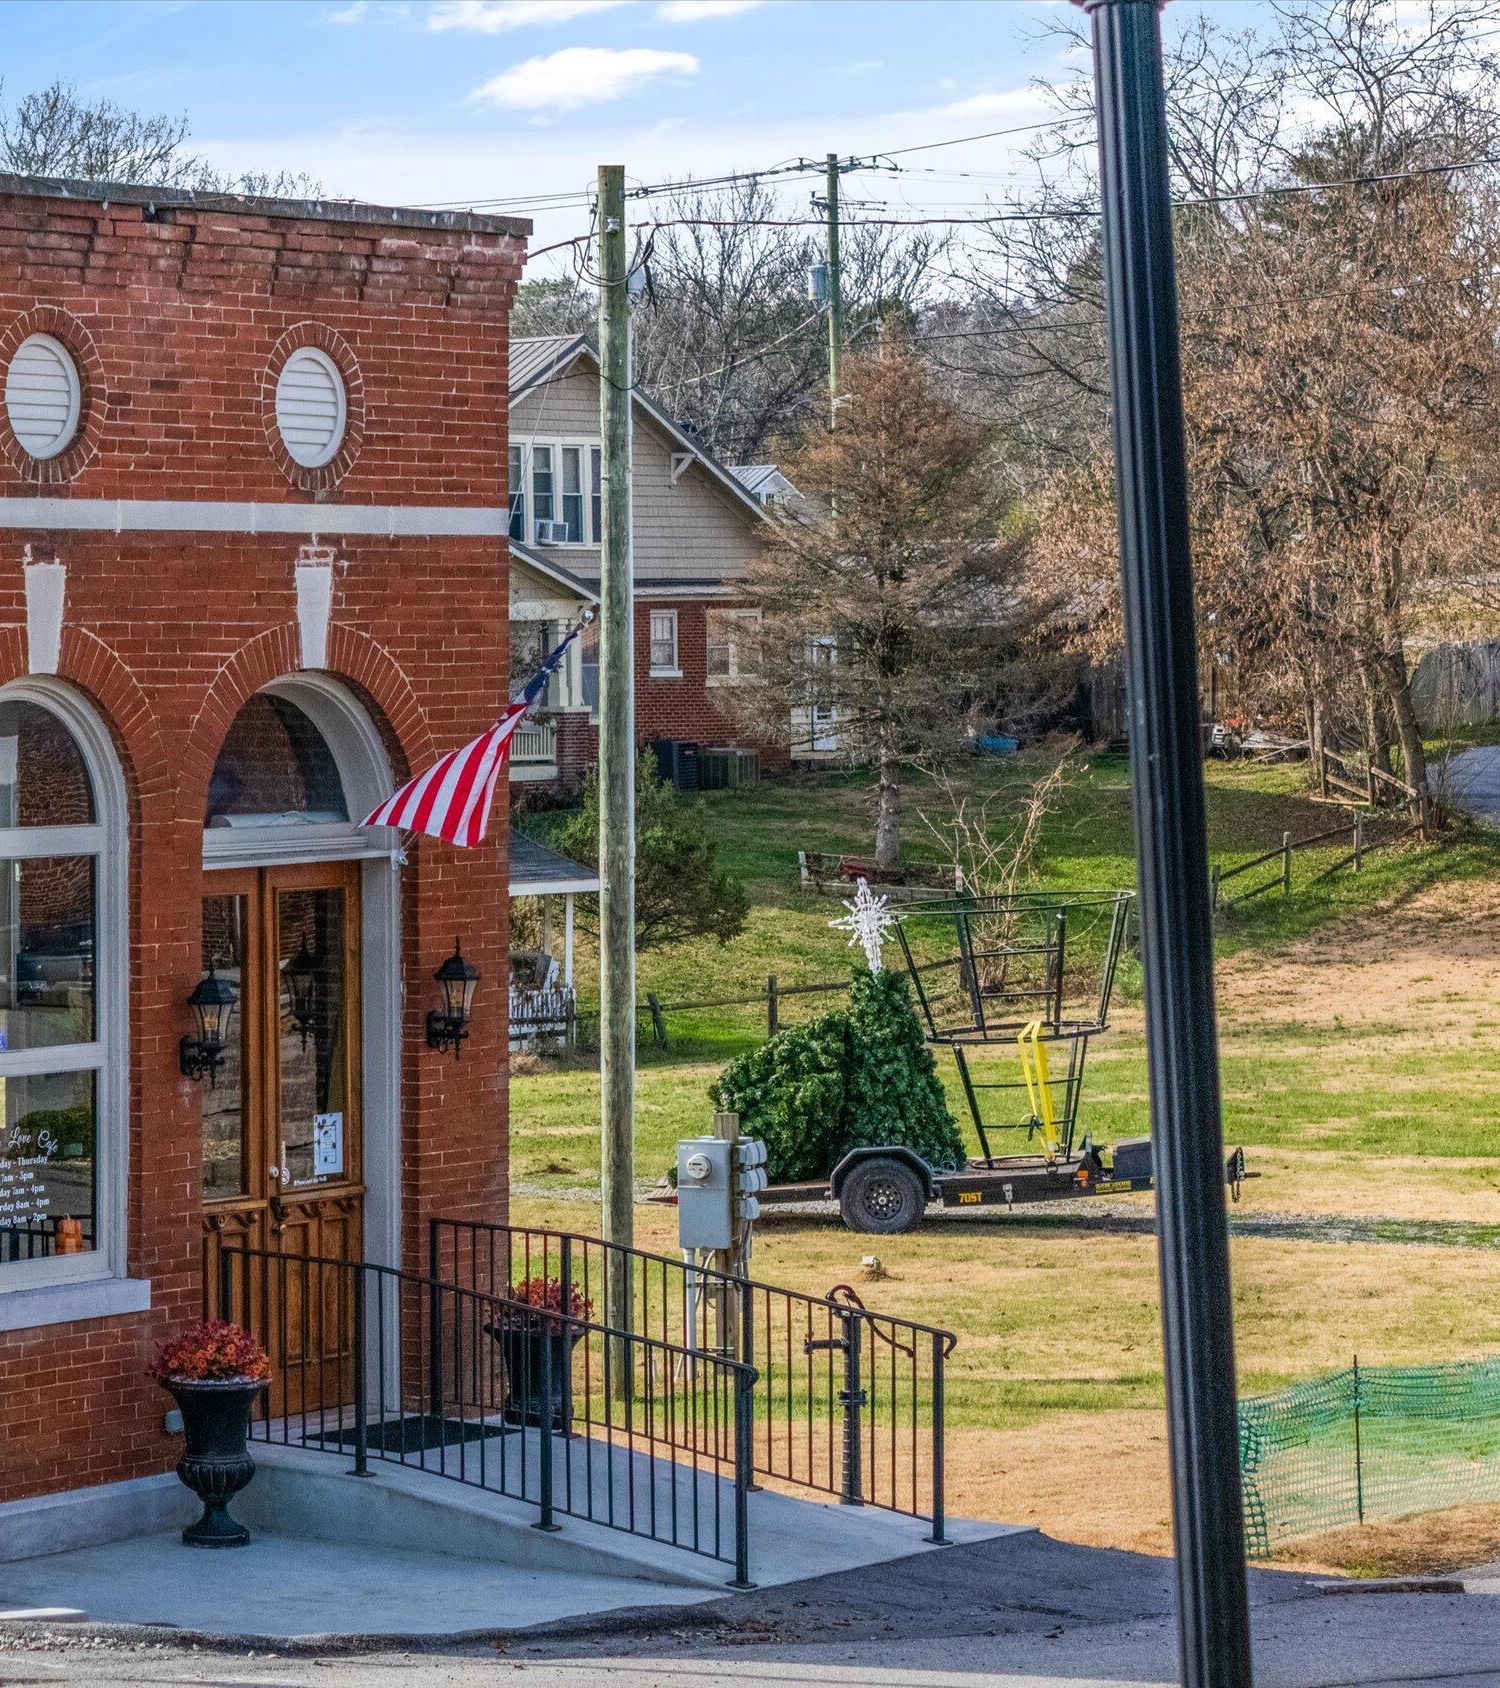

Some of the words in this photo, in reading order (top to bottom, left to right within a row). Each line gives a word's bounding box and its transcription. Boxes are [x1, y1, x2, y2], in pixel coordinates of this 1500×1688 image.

[8, 1126, 32, 1148] Love
[37, 1129, 59, 1156] Cafe
[18, 1155, 48, 1166] Thursday
